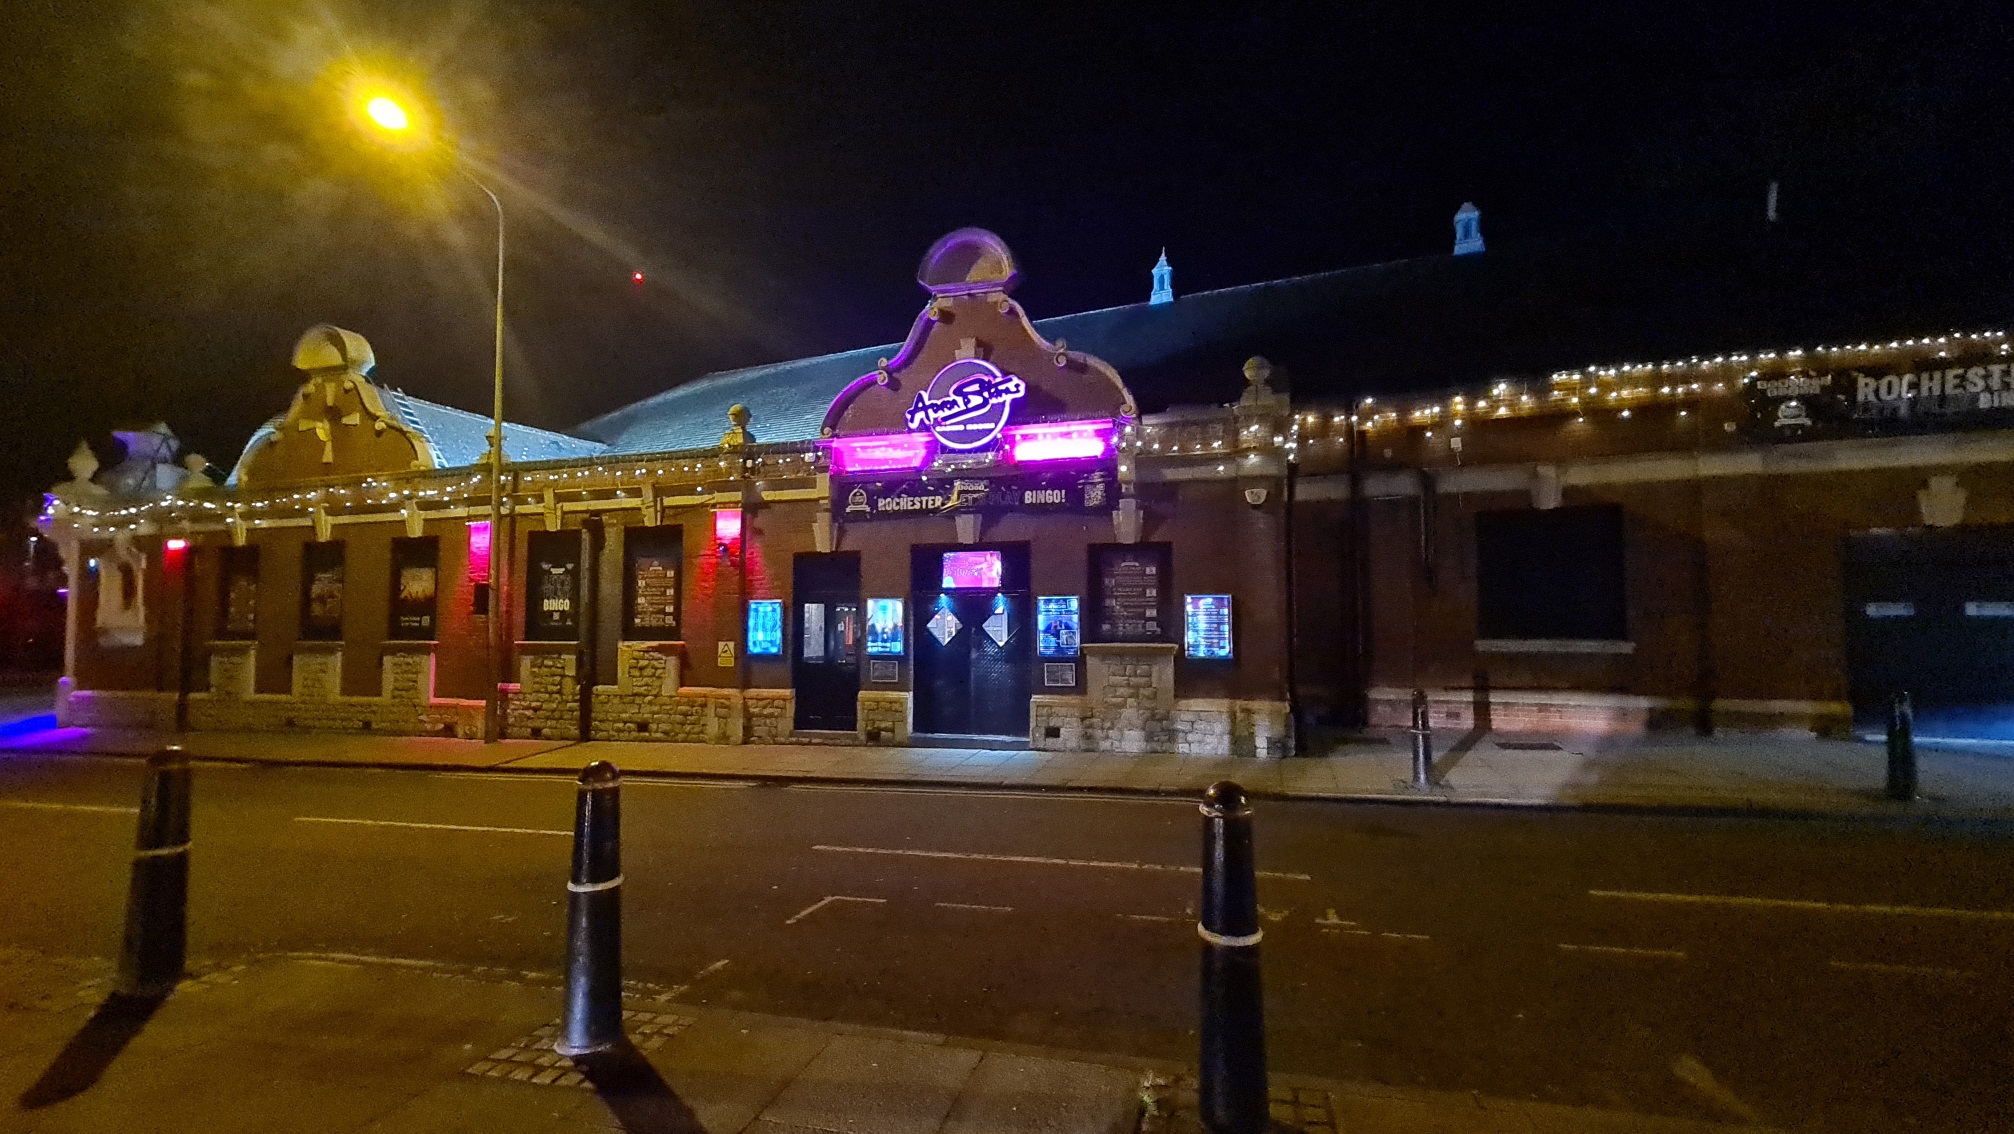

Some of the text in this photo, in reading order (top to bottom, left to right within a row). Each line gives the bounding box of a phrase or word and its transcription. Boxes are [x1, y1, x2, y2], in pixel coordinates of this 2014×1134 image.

[877, 495, 943, 511] ROCHESTER
[1024, 489, 1066, 504] BINGO!
[543, 598, 570, 611] BINGO
